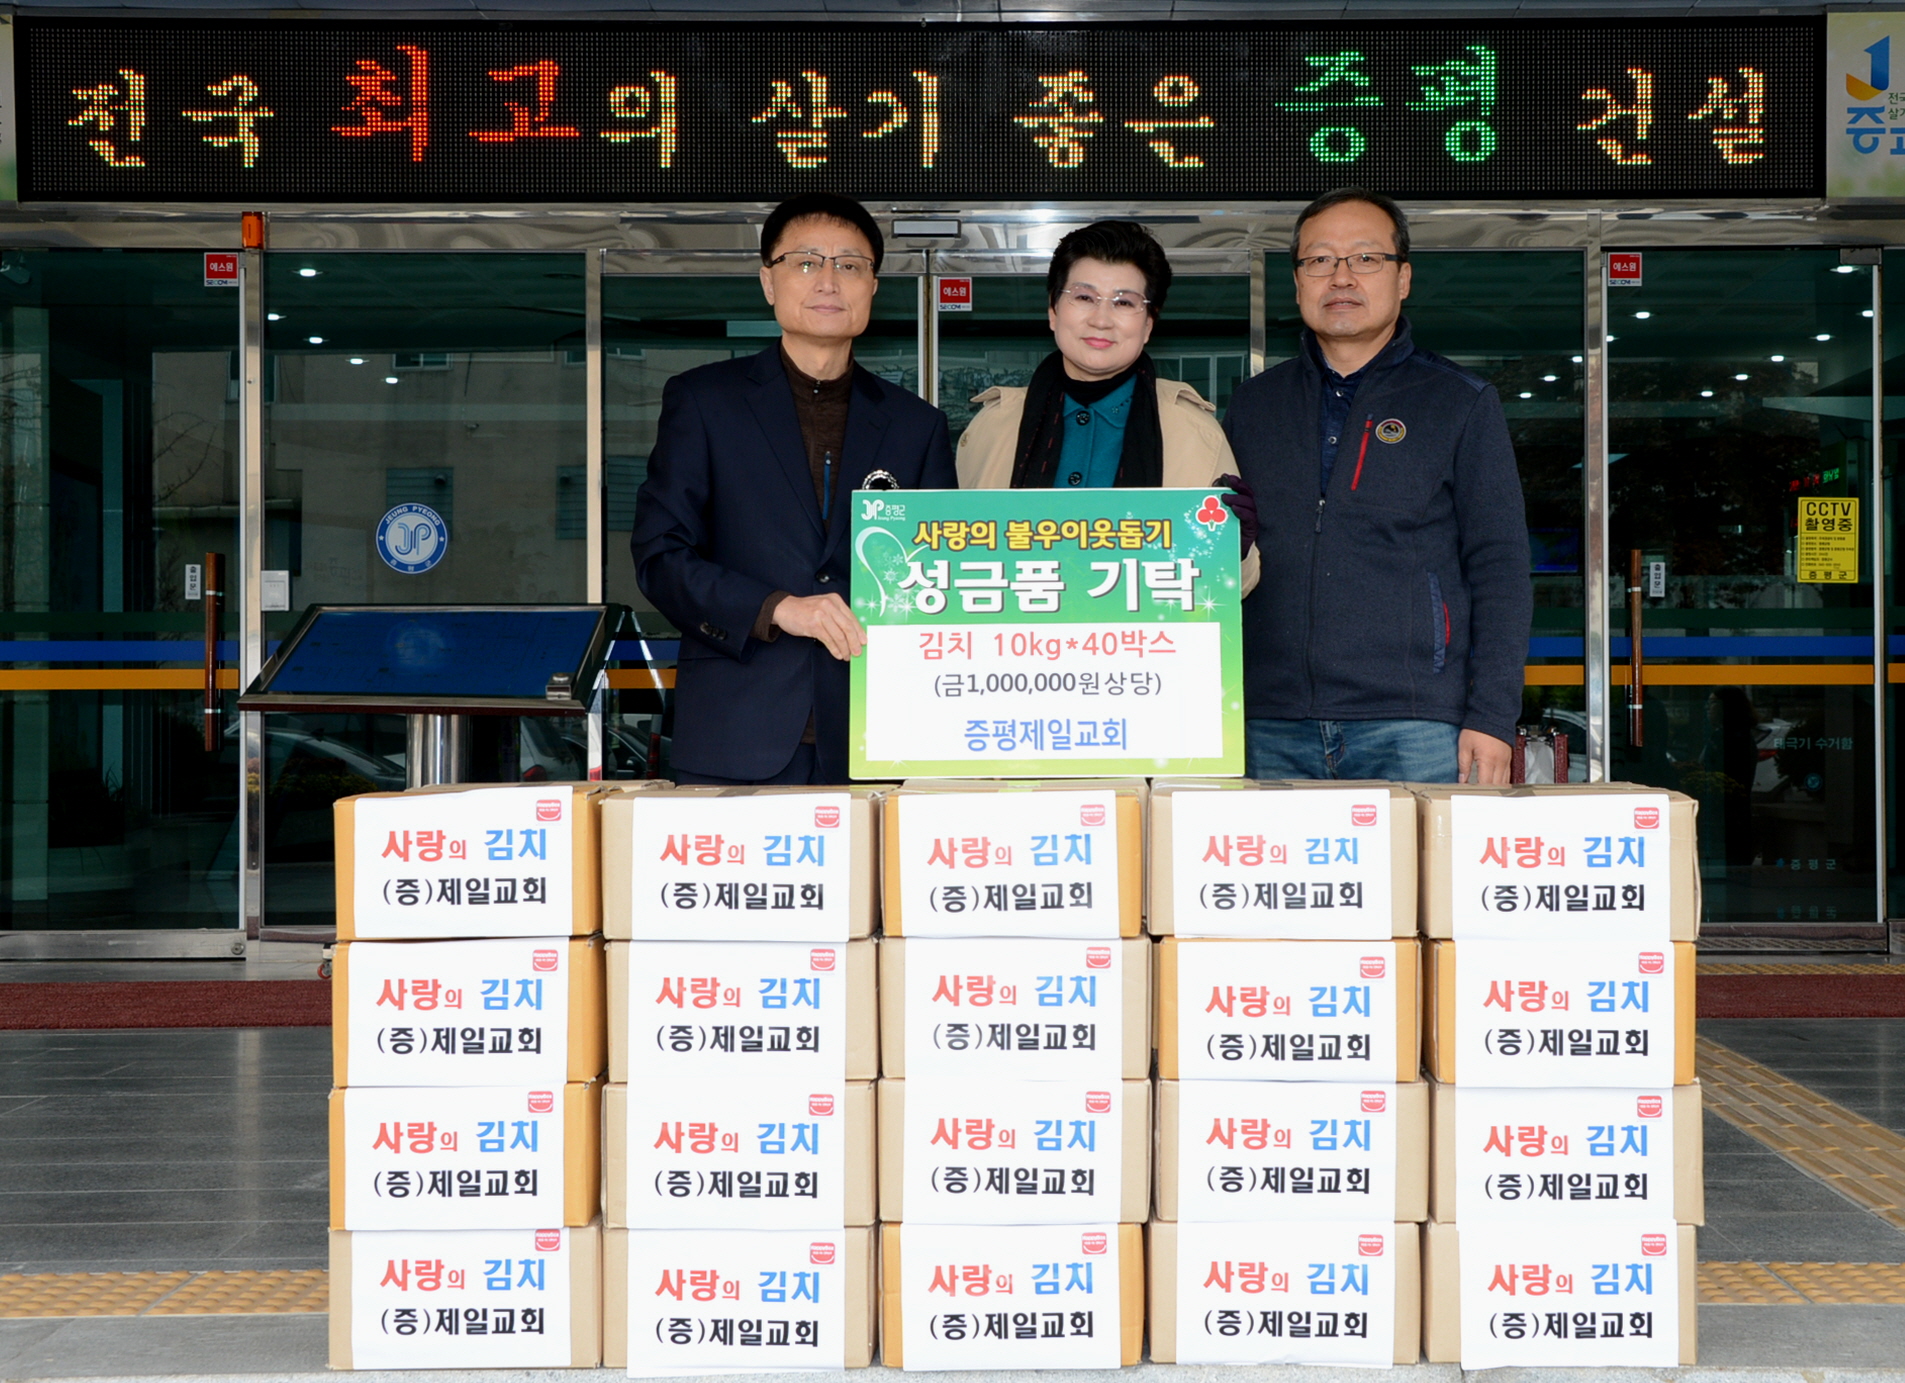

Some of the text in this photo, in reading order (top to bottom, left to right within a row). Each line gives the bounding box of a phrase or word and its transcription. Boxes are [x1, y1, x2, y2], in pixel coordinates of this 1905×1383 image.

[67, 45, 1764, 169] 전국 최고의 살기 좋은 증평 건설
[209, 262, 234, 272] 에스원
[1612, 261, 1637, 272] 에스원
[943, 286, 967, 297] 에스원
[385, 505, 441, 527] JEUNG PYEONG
[1805, 517, 1853, 532] 촬영중
[1806, 501, 1852, 517] CCTV
[913, 518, 1172, 551] 사랑의 불우이웃돕기
[897, 557, 1201, 614] 성금품 기탁
[918, 630, 973, 661] 김치
[964, 717, 1128, 752] 증평제일교회
[1815, 737, 1853, 750] 수거함
[381, 828, 547, 863] 사랑의 김치
[659, 833, 825, 867] 사랑의 김치
[927, 833, 1093, 870] 사랑의 김치
[1202, 834, 1359, 867] 사랑의 김치
[1479, 835, 1646, 869] 사랑의 김치
[383, 876, 547, 906] (증)제일교회
[660, 882, 824, 911] (증)제일교회
[929, 881, 1093, 913] (증)제일교회
[1199, 881, 1363, 910] (증)제일교회
[1481, 884, 1645, 913] (증)제일교회
[376, 978, 544, 1012] 사랑의 김치
[655, 976, 821, 1010] 사랑의 김치
[932, 974, 1097, 1008] 사랑의 김치
[1205, 985, 1371, 1018] 사랑의 김치
[1483, 979, 1650, 1014] 사랑의 김치
[377, 1027, 542, 1055] (증)제일교회
[656, 1025, 820, 1053] (증)제일교회
[933, 1023, 1096, 1051] (증)제일교회
[1206, 1033, 1371, 1062] (증)제일교회
[1484, 1028, 1649, 1057] (증)제일교회
[371, 1119, 539, 1155] 사랑의 김치
[653, 1121, 820, 1156] 사랑의 김치
[930, 1117, 1097, 1153] 사랑의 김치
[1205, 1117, 1372, 1152] 사랑의 김치
[1483, 1124, 1649, 1158] 사랑의 김치
[373, 1169, 538, 1199] (증)제일교회
[654, 1170, 818, 1199] (증)제일교회
[931, 1166, 1095, 1197] (증)제일교회
[1207, 1166, 1370, 1195] (증)제일교회
[1484, 1173, 1648, 1201] (증)제일교회
[379, 1258, 546, 1292] 사랑의 김치
[655, 1268, 821, 1304] 사랑의 김치
[928, 1261, 1094, 1297] 사랑의 김치
[1203, 1260, 1369, 1296] 사랑의 김치
[1487, 1262, 1654, 1297] 사랑의 김치
[381, 1307, 545, 1336] (증)제일교회
[655, 1317, 819, 1348] (증)제일교회
[929, 1310, 1094, 1341] (증)제일교회
[1204, 1309, 1368, 1339] (증)제일교회
[1489, 1311, 1653, 1340] (증)제일교회
